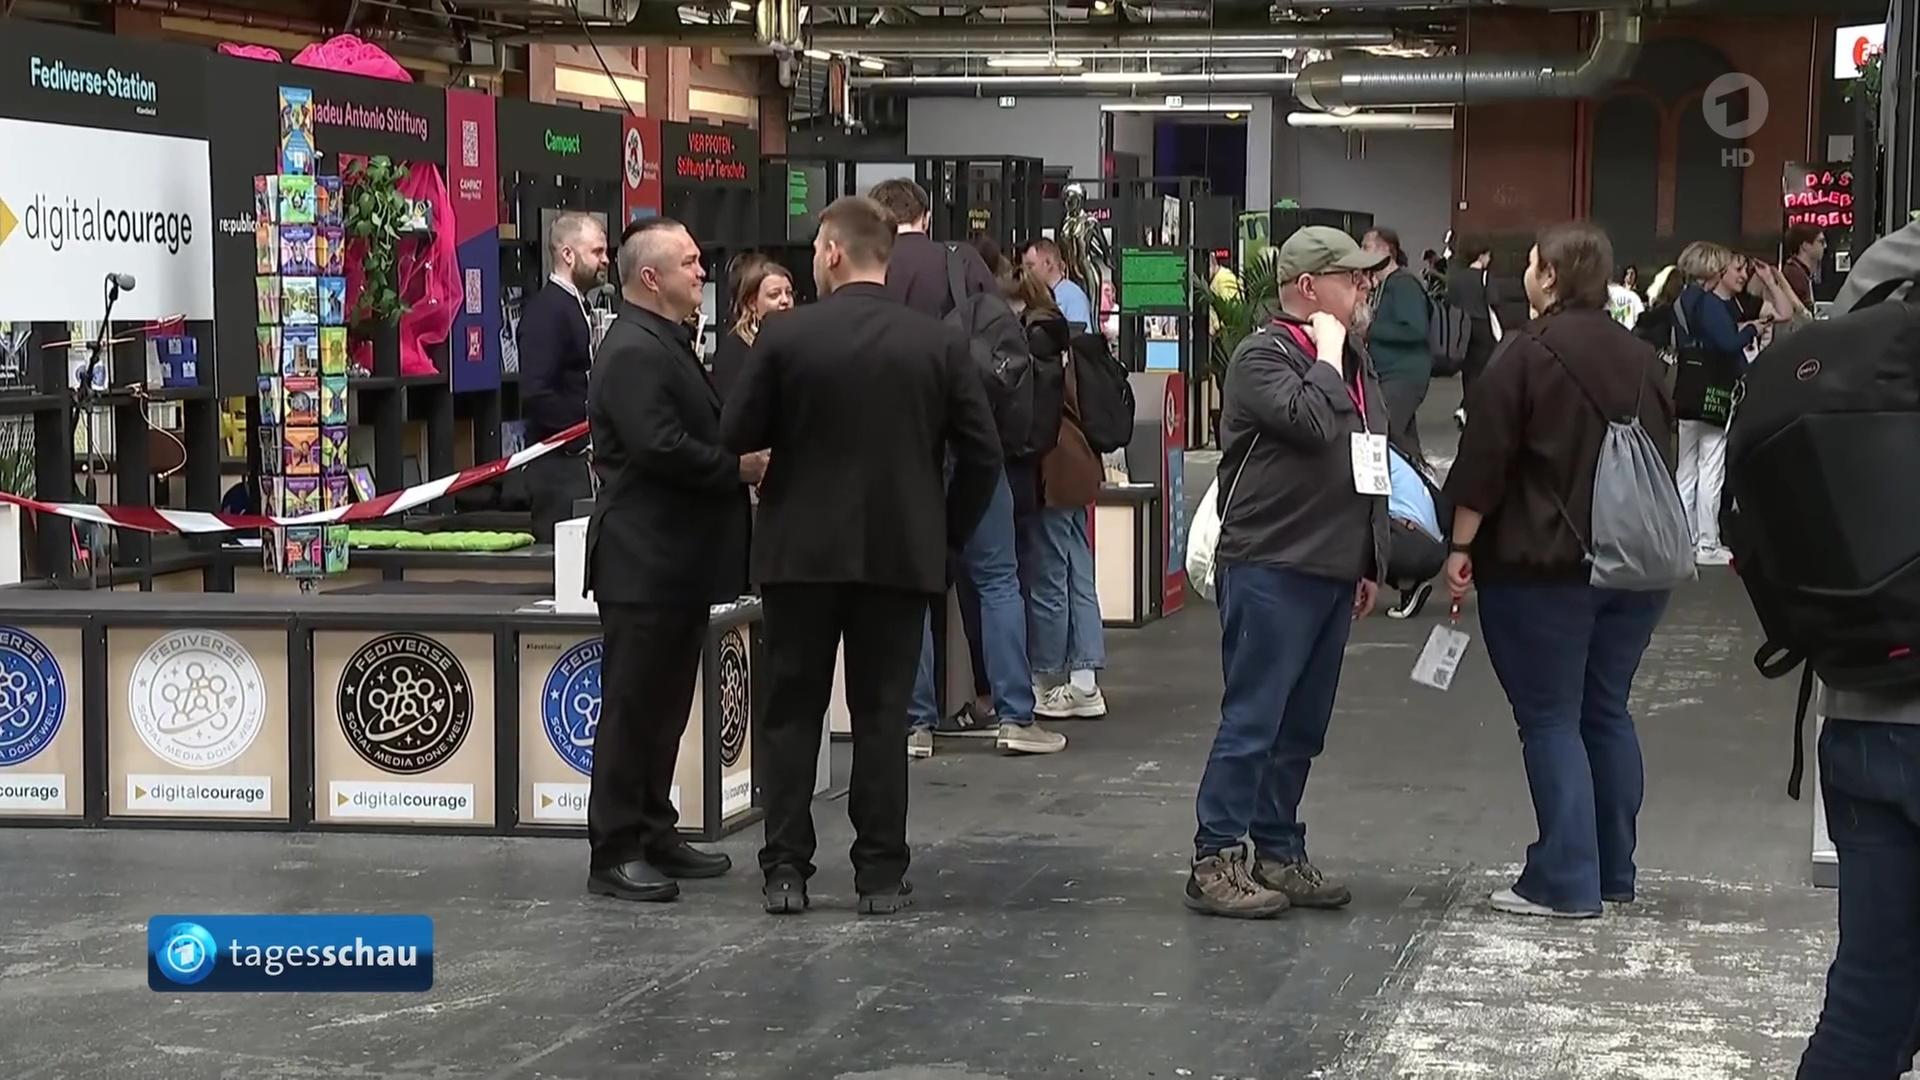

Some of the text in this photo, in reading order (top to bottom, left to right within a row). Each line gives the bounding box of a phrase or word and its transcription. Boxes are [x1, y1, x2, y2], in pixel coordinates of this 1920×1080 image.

[30, 56, 157, 102] Fediverse-Station
[313, 98, 428, 141] adeu Antonio Stiftung
[545, 129, 580, 156] Campact
[688, 132, 704, 153] VIER
[705, 134, 731, 155] PFOTEN
[677, 155, 704, 181] Stiftung
[705, 158, 715, 177] für
[715, 159, 746, 179] Tierschutz
[1805, 171, 1853, 187] DAS
[25, 194, 192, 255] digitalcourage
[150, 634, 246, 668] FEDIVERSE
[355, 639, 453, 673] FEDIVERSE
[8, 703, 58, 758] DONE WELL
[138, 703, 162, 747] SOCIAL
[164, 744, 203, 761] MEDIA
[206, 739, 238, 760] DONE
[346, 710, 465, 767] SOCIAL MEDIA DONE WELL
[551, 716, 580, 759] SOCIAL
[151, 784, 265, 802] digitalcourage
[353, 791, 467, 810] digitalcourage
